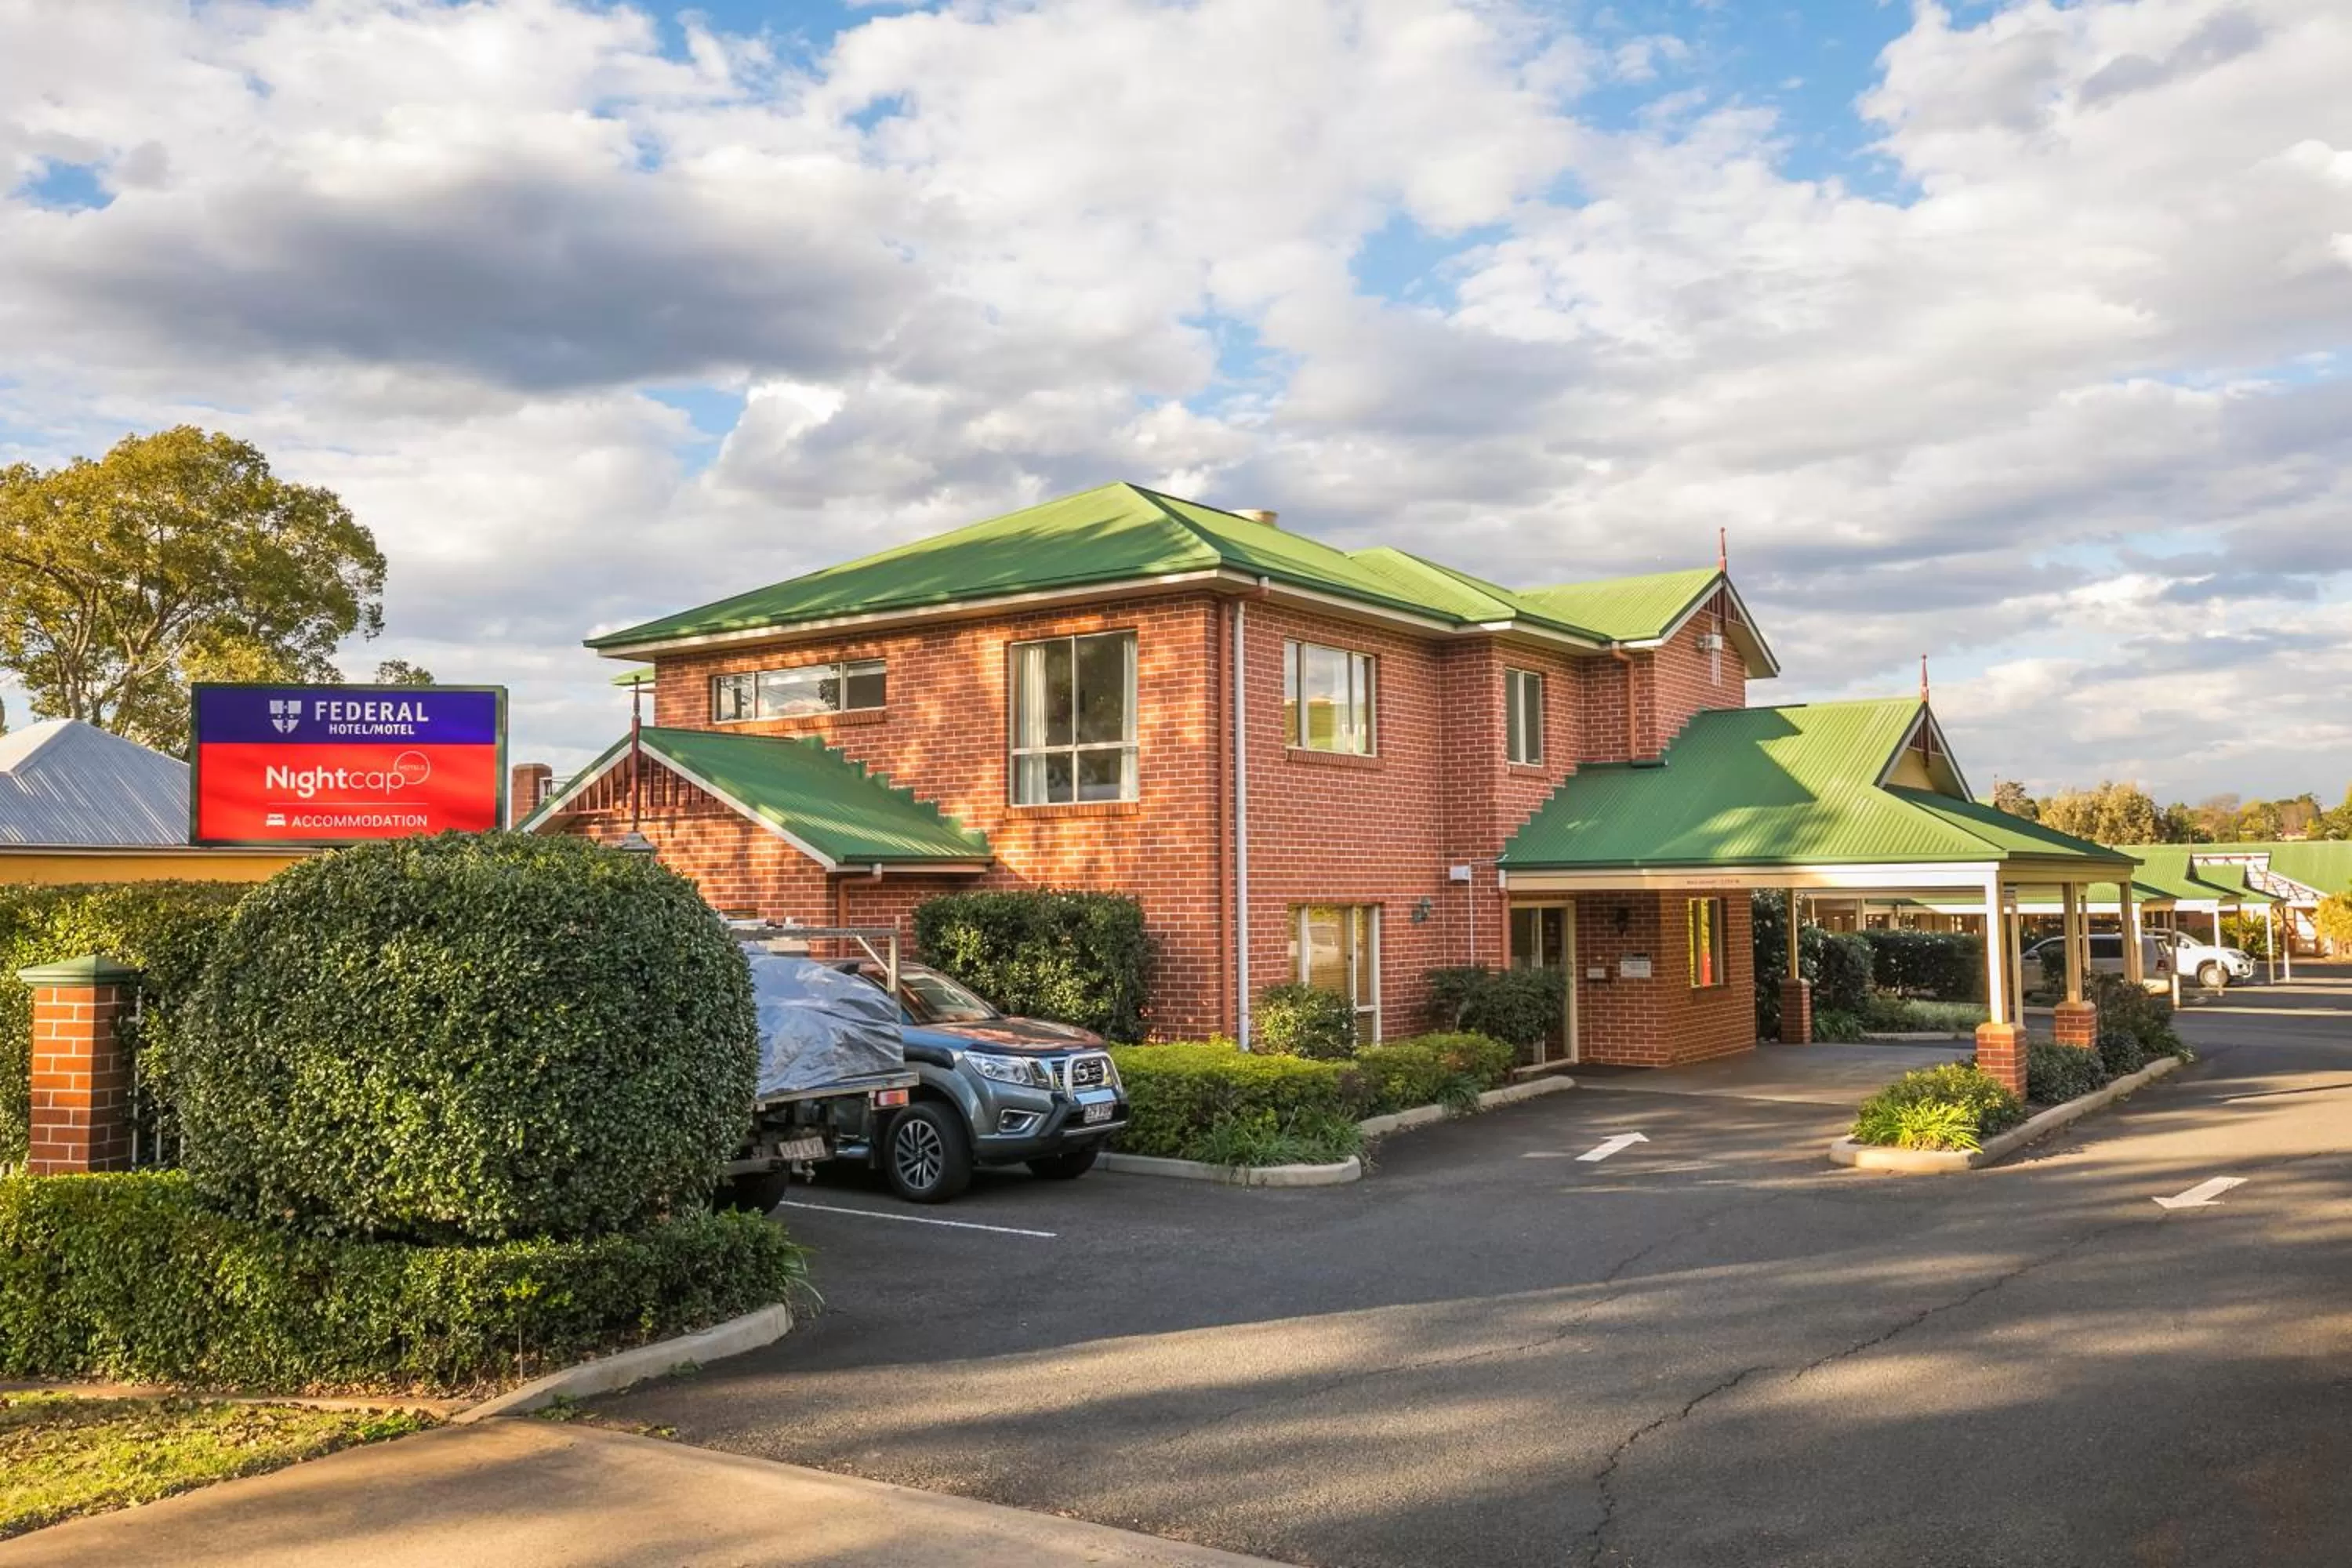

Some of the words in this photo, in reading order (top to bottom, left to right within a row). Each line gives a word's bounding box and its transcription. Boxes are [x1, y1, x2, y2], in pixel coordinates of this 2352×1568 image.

[314, 701, 429, 722] FEDERAL
[328, 724, 415, 735] HOTEL/MOTEL
[266, 765, 405, 798] Nightcap
[292, 815, 428, 828] ACCOMMODATION
